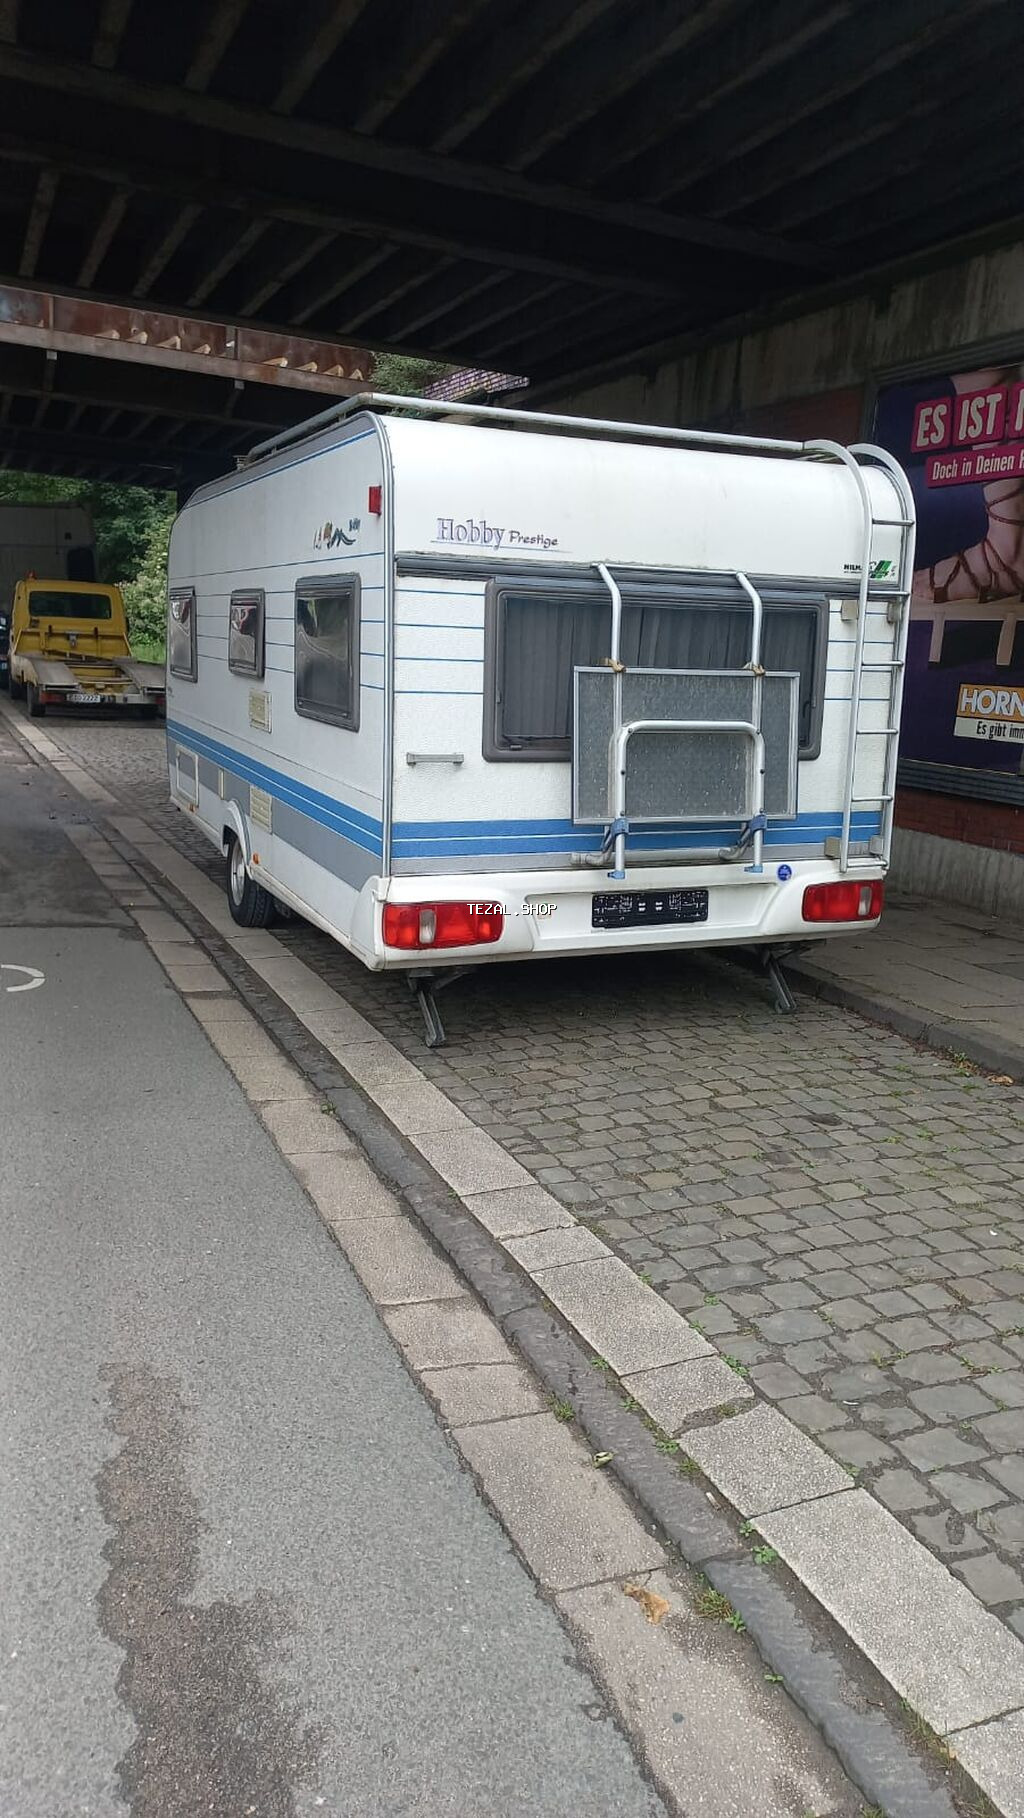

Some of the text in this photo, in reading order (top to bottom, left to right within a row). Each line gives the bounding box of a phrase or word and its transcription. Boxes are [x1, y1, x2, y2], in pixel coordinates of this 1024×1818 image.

[916, 403, 948, 447] ES
[958, 393, 1003, 440] IST
[932, 459, 958, 480] Doch
[961, 457, 972, 476] in
[975, 453, 1015, 475] Deinen
[436, 518, 559, 550] Hobby Prestige
[976, 720, 987, 735] Es
[989, 722, 1007, 739] gibt
